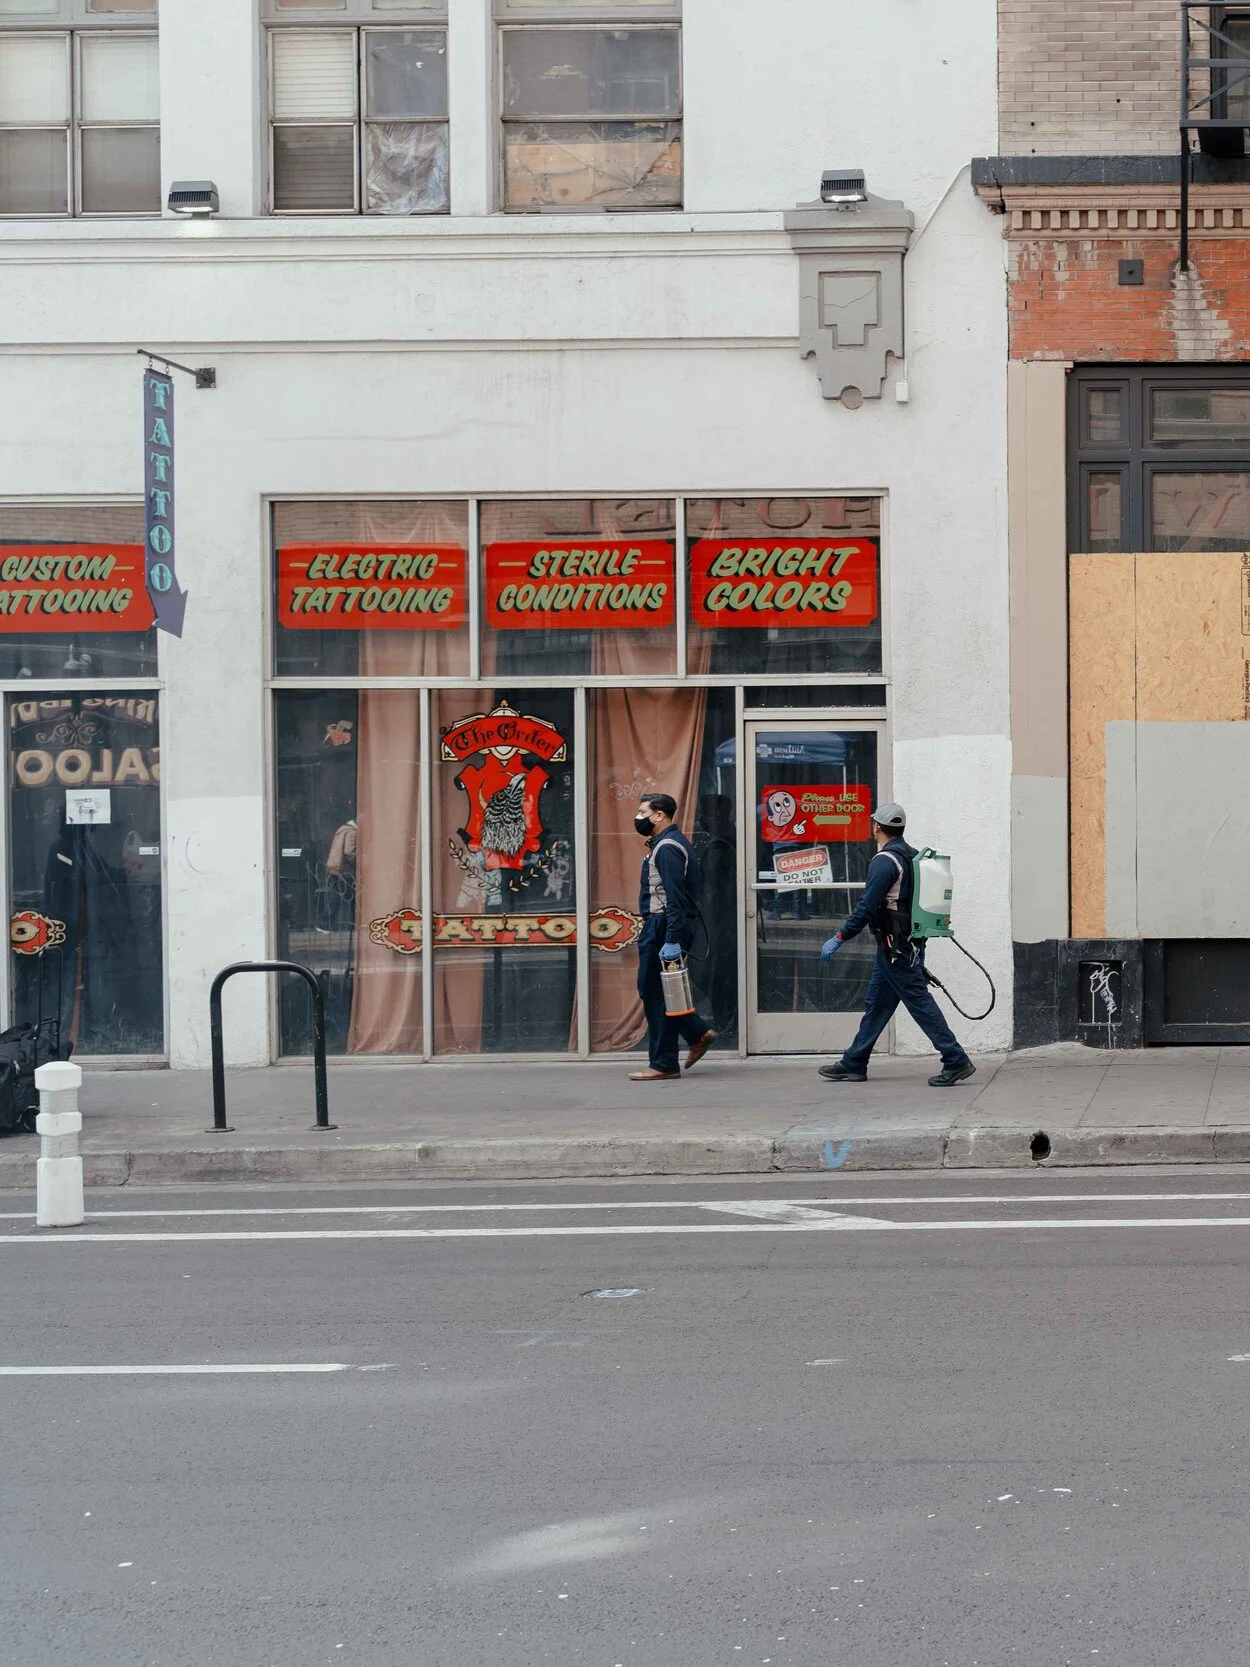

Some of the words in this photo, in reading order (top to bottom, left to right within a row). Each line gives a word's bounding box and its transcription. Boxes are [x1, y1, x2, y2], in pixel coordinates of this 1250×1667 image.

[149, 378, 173, 593] TATTOO
[1, 554, 117, 582] CUSTOM
[306, 553, 438, 580] ELECTRIC
[527, 548, 642, 579] STERILE
[706, 546, 861, 578] BRIGHT
[289, 586, 454, 614] TATTOOING
[496, 582, 667, 613] CONDITIONS
[703, 580, 853, 613] COLORS
[451, 724, 494, 751] The
[496, 721, 557, 753] Order
[800, 803, 834, 813] OTHER
[835, 803, 865, 813] DOOR
[838, 793, 858, 803] USE
[780, 854, 823, 869] DANGER
[783, 873, 799, 882] DO
[802, 867, 825, 878] NOT
[788, 875, 822, 884] TER
[401, 917, 622, 941] TATTOO
